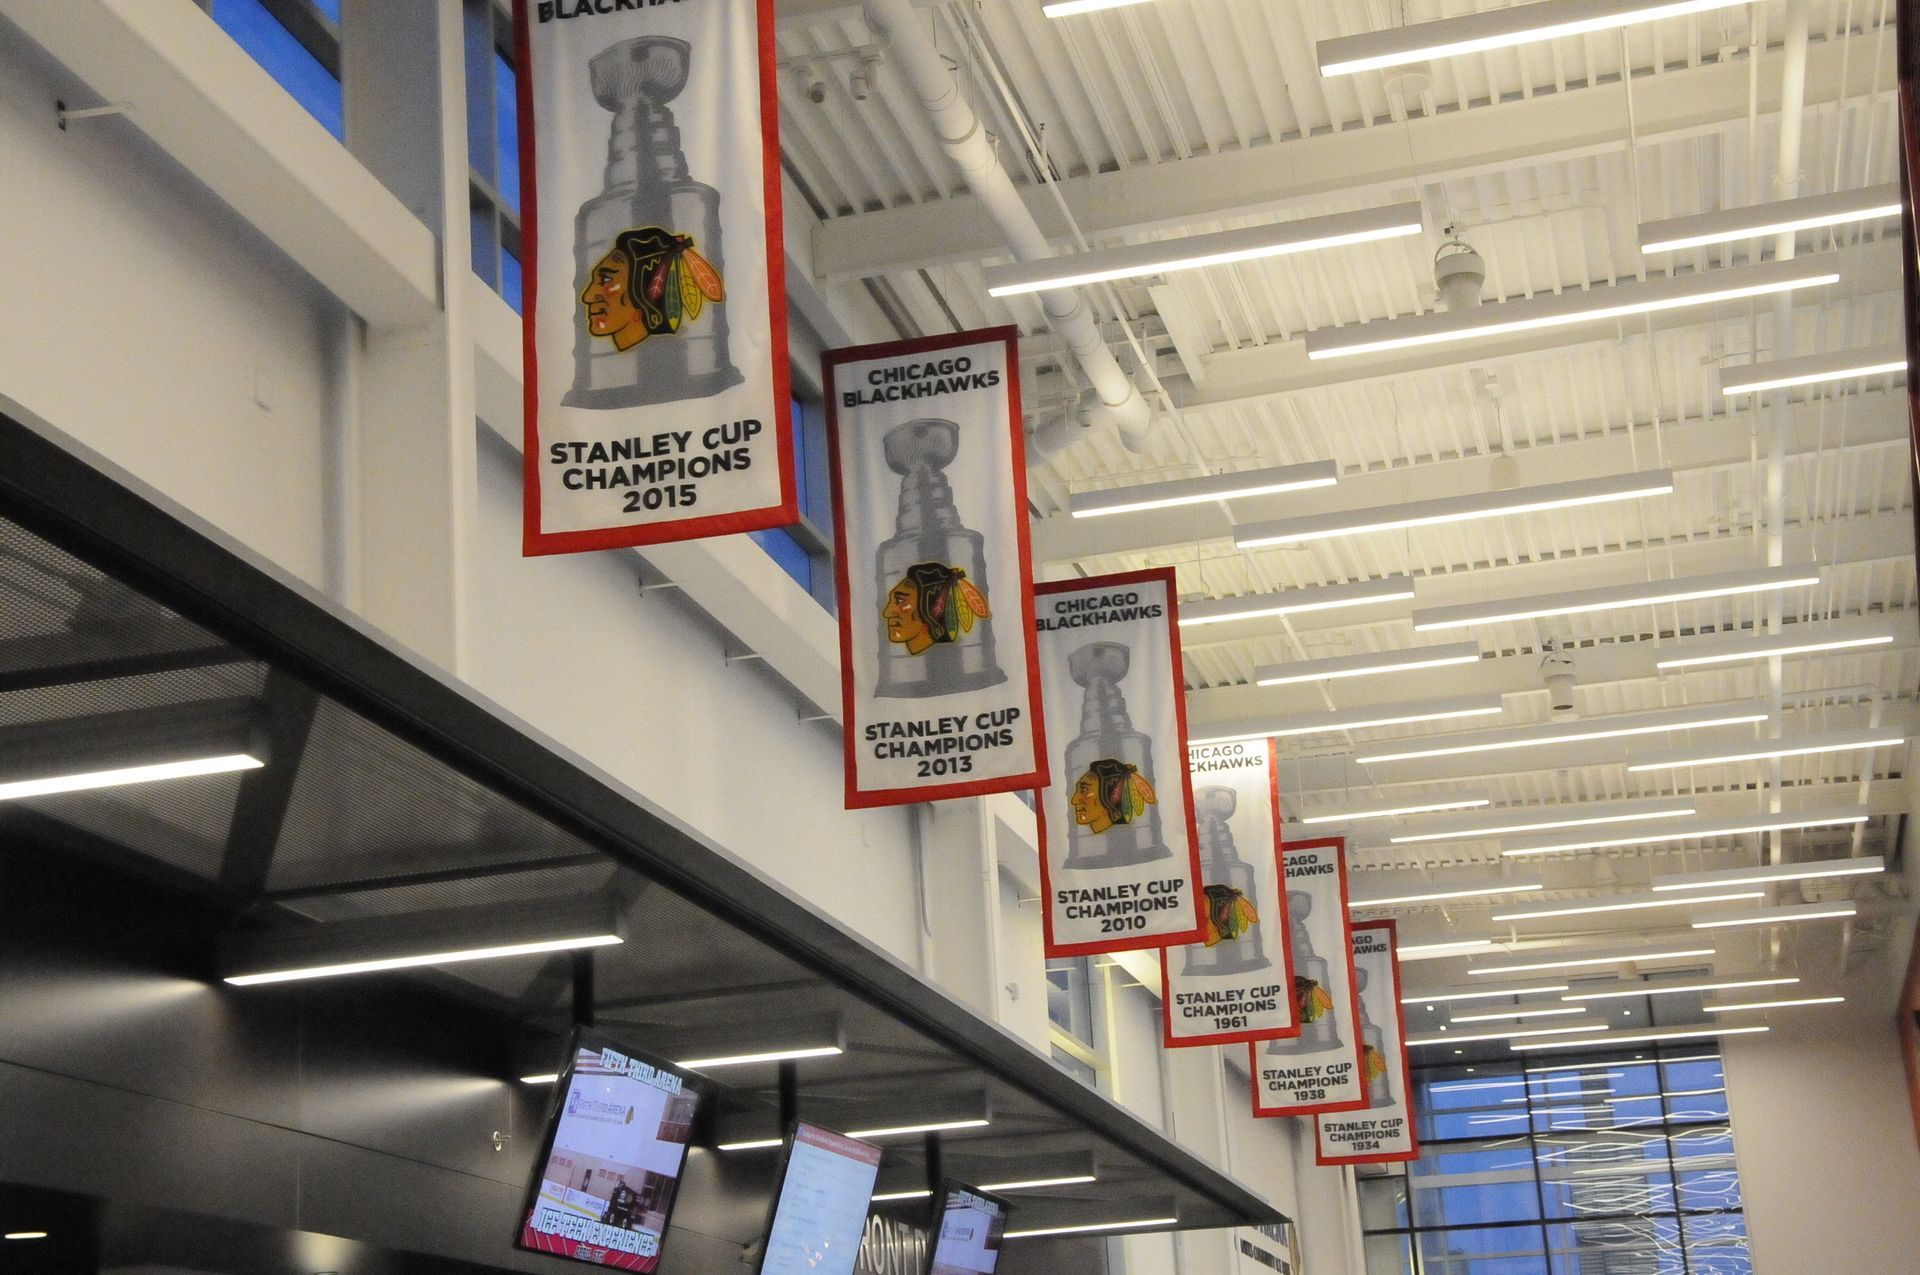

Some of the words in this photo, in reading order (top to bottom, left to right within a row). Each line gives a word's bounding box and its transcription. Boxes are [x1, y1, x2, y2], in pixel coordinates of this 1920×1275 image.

[867, 356, 972, 386] CHICAGO
[842, 370, 1000, 408] BLACKHAWKS
[550, 431, 693, 465] STANLEY
[702, 419, 762, 450] CUP
[562, 448, 751, 490] CHAMPIONS
[622, 484, 697, 513] 2015
[1055, 592, 1139, 614] CHICAGO
[1036, 604, 1162, 631] BLACKHAWKS
[865, 715, 968, 741] STANLEY
[975, 707, 1020, 730] CUP
[874, 729, 1014, 759] CHAMPIONS
[1188, 744, 1244, 760] HICAGO
[917, 755, 973, 778] 2013
[1189, 755, 1263, 773] CKHAWKS
[1286, 863, 1334, 878] HAWKS
[1057, 883, 1141, 904] STANLEY
[1147, 878, 1184, 895] CUP
[1066, 895, 1179, 919] CHAMPIONS
[1100, 915, 1146, 933] 2010
[1176, 988, 1246, 1005] STANLEY
[1250, 984, 1281, 998] CUP
[1183, 999, 1277, 1018] CHAMPIONS
[1214, 1015, 1248, 1030] 1961
[1262, 1066, 1322, 1080] STANLEY
[1326, 1062, 1353, 1074] CUP
[1268, 1075, 1349, 1091] CHAMPIONS
[1294, 1089, 1326, 1101] 1938
[1324, 1120, 1377, 1132] STANLEY
[1380, 1118, 1403, 1129] CUP
[1329, 1129, 1400, 1142] CHAMPIONS
[1352, 1141, 1380, 1151] 1934
[859, 1214, 910, 1275] RONT
